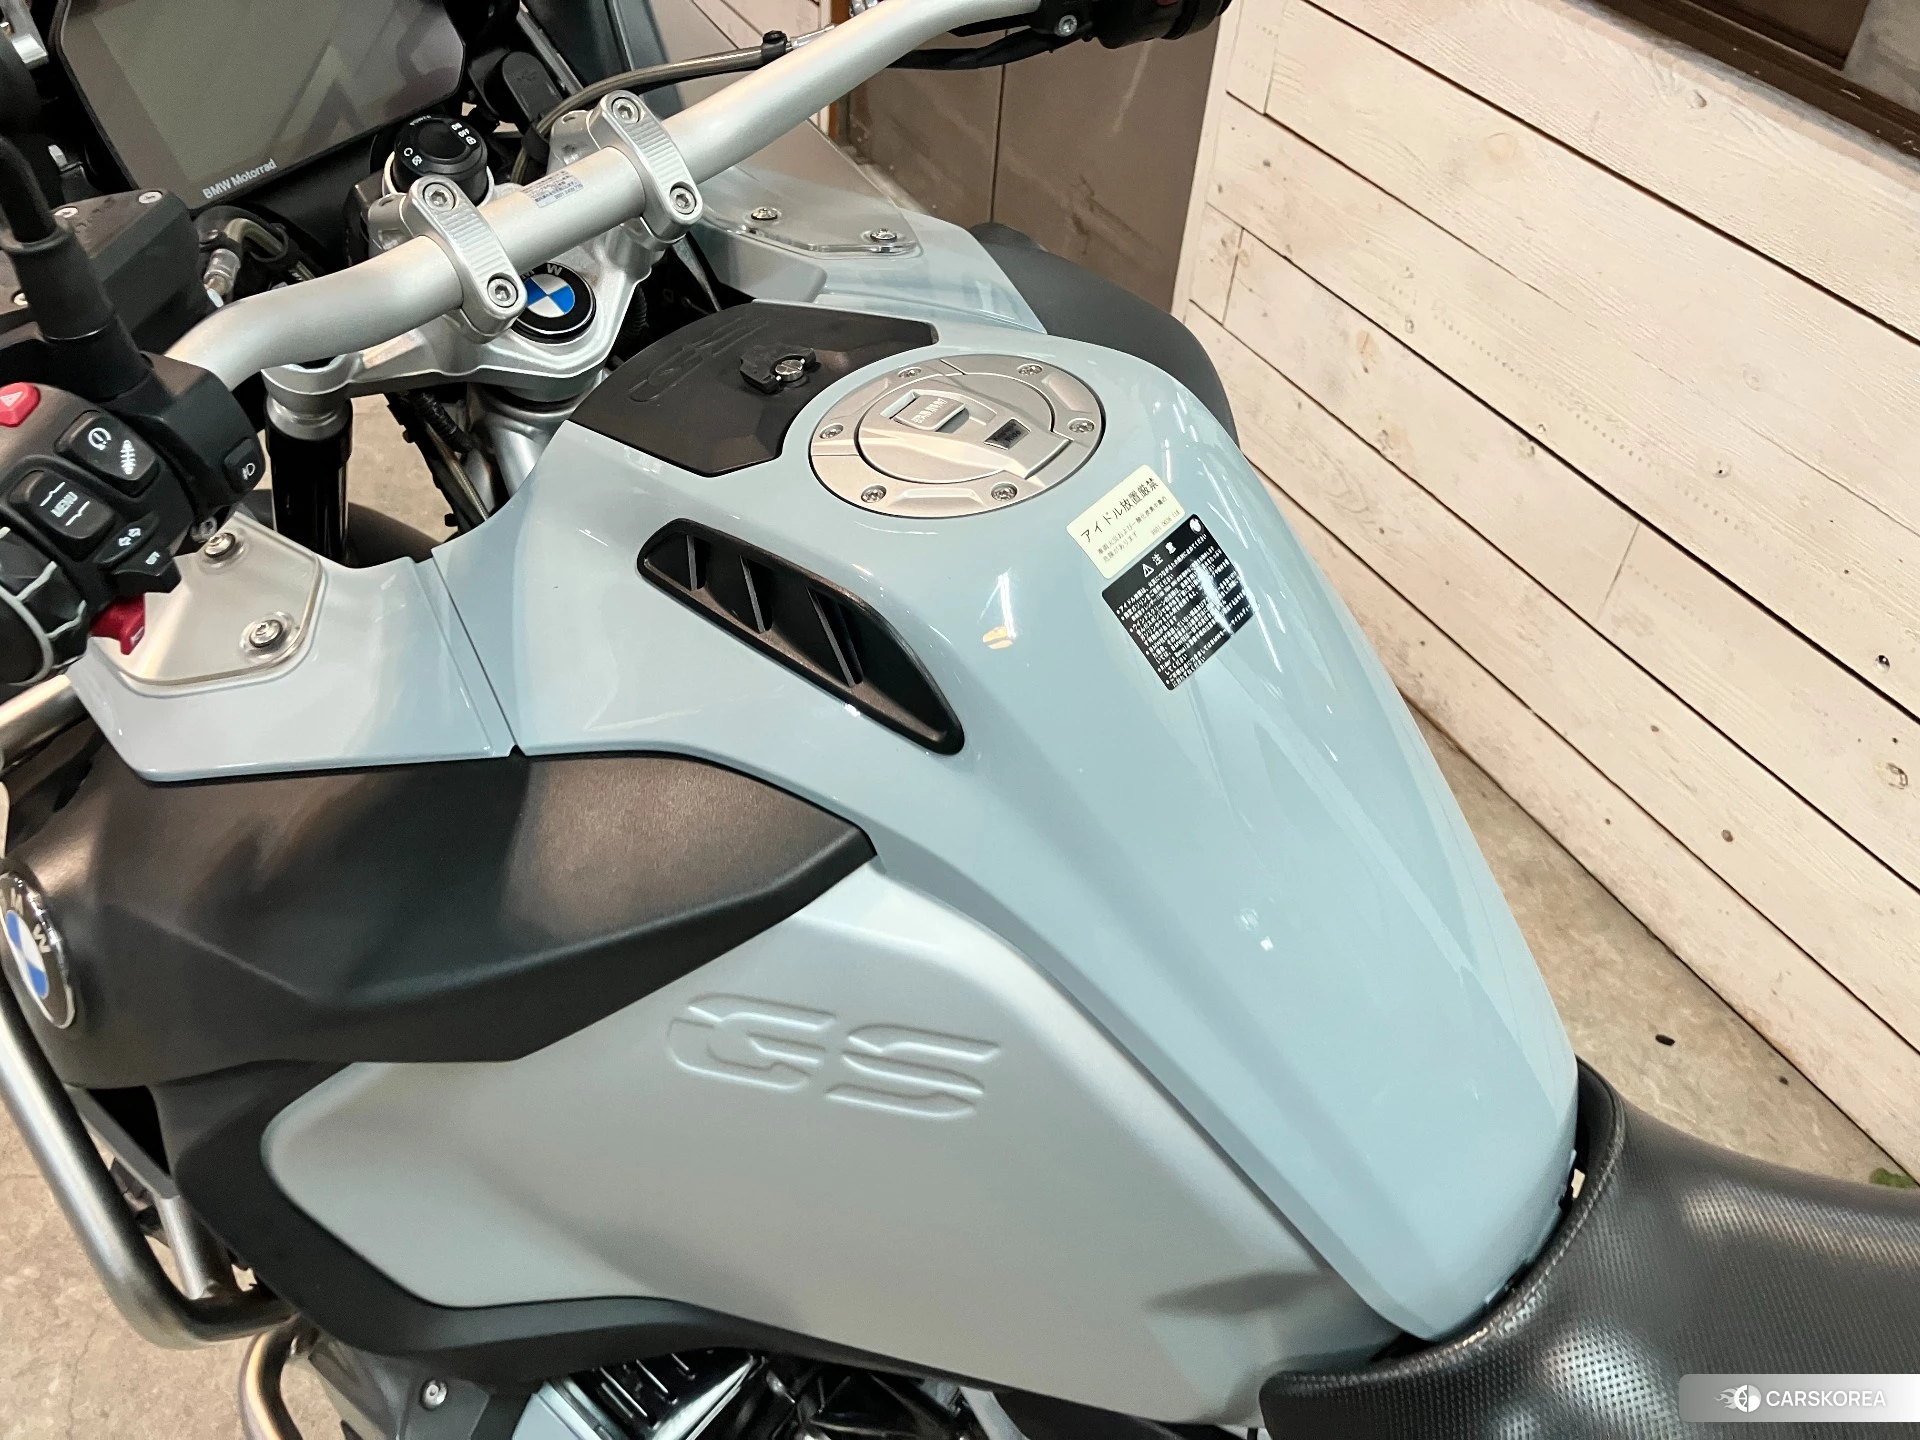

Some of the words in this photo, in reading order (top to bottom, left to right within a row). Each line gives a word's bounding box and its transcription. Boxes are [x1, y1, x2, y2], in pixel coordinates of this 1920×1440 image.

[202, 178, 232, 199] BMW
[230, 157, 278, 187] Motorrad
[1080, 477, 1160, 542] アイドル放置厳禁
[667, 992, 1001, 1121] GS
